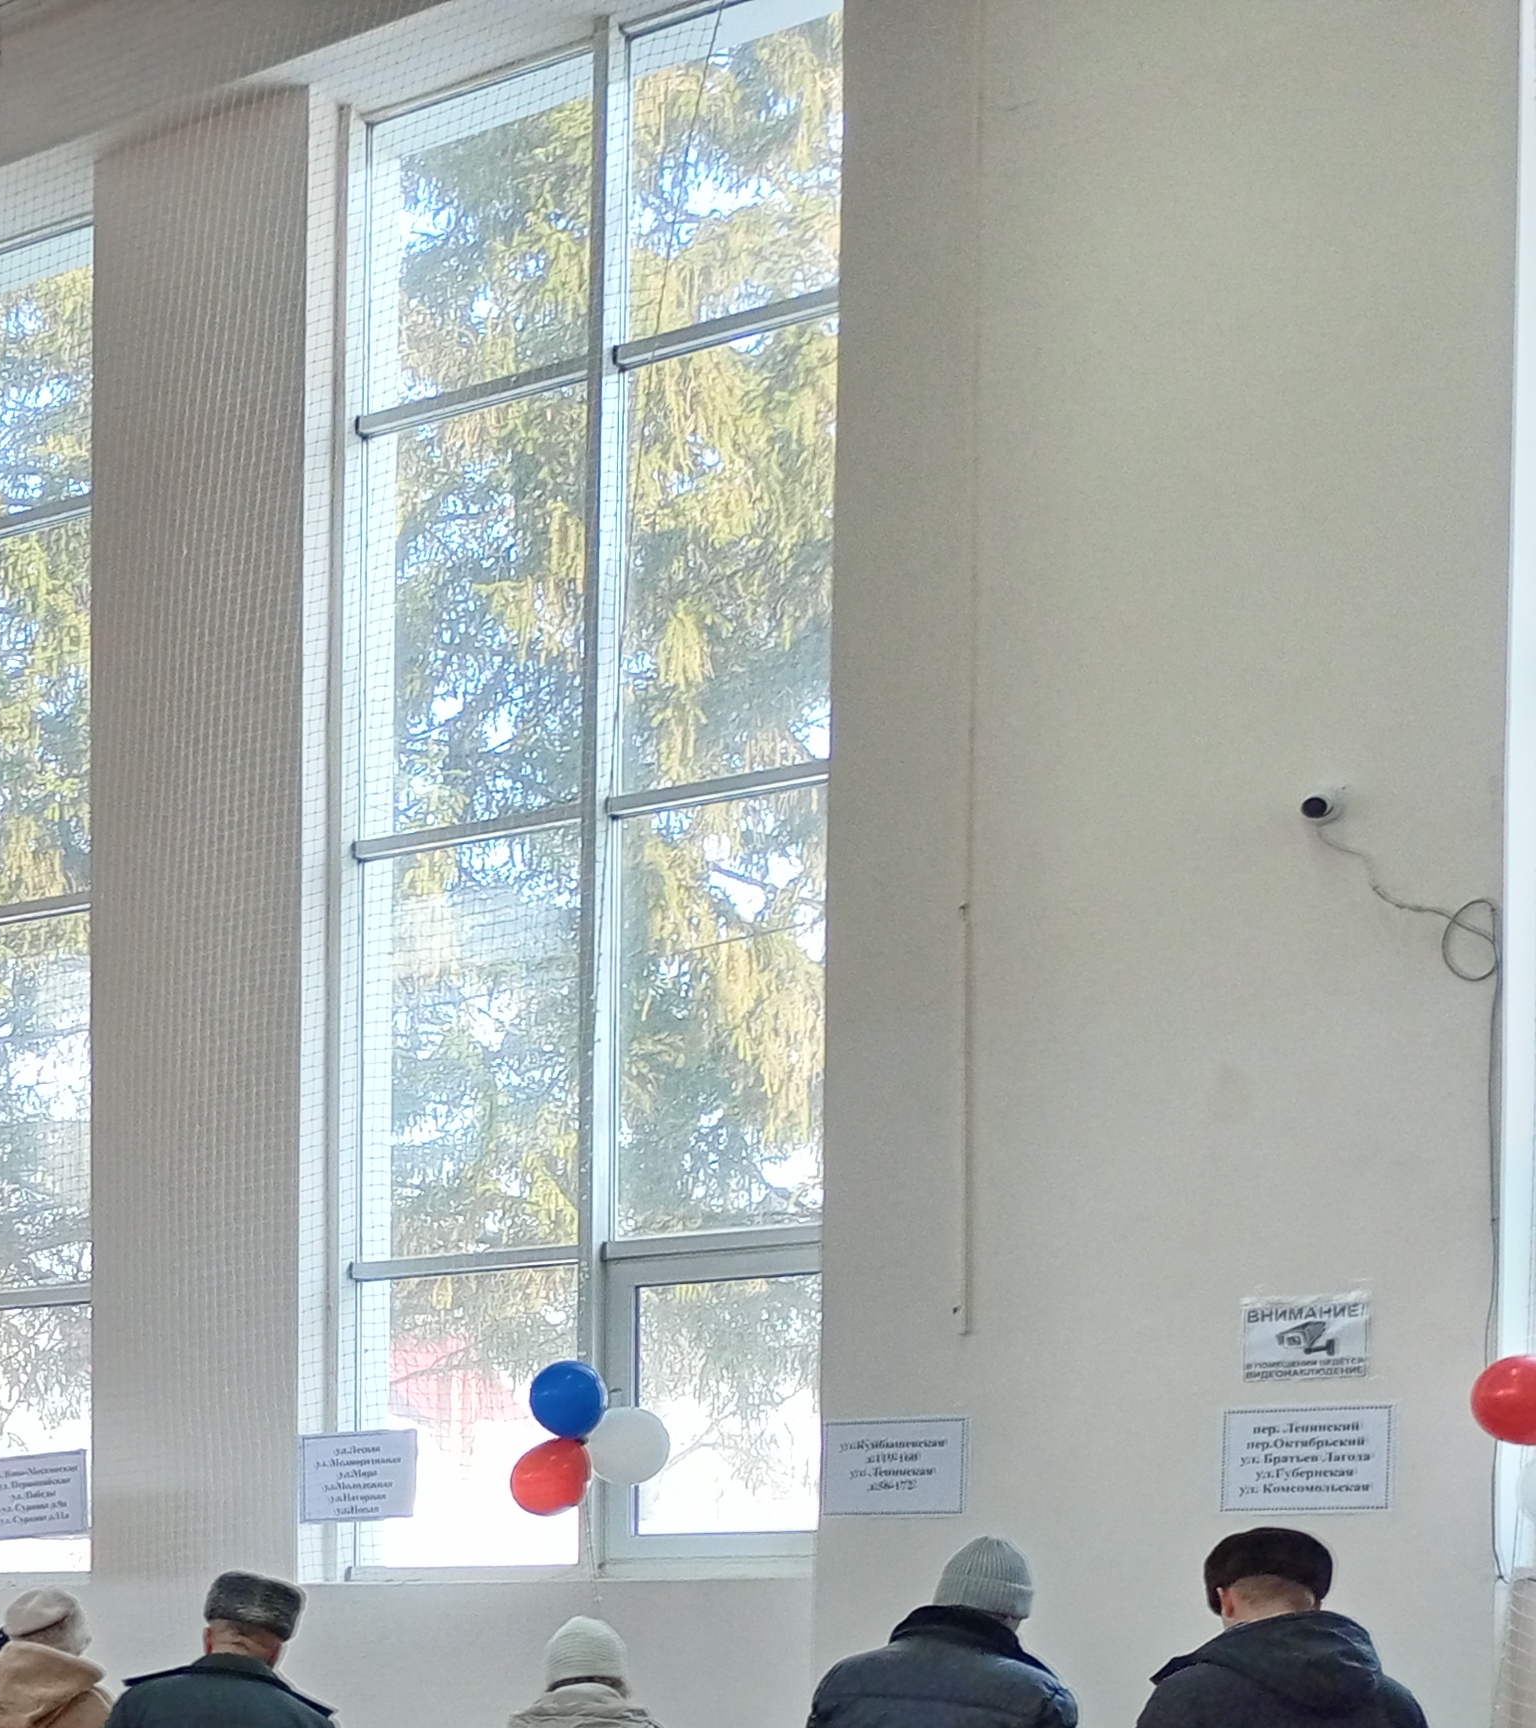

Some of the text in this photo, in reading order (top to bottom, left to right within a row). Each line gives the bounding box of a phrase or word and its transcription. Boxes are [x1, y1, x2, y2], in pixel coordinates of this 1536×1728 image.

[1247, 1303, 1366, 1323] ВНИМАНИЕ!
[1245, 1366, 1364, 1380] ВИДЕОНАБЛЮДЕНИЕ
[1282, 1421, 1360, 1433] Ленинский
[1263, 1453, 1319, 1466] Братьев
[1263, 1482, 1370, 1494] Комсомольская
